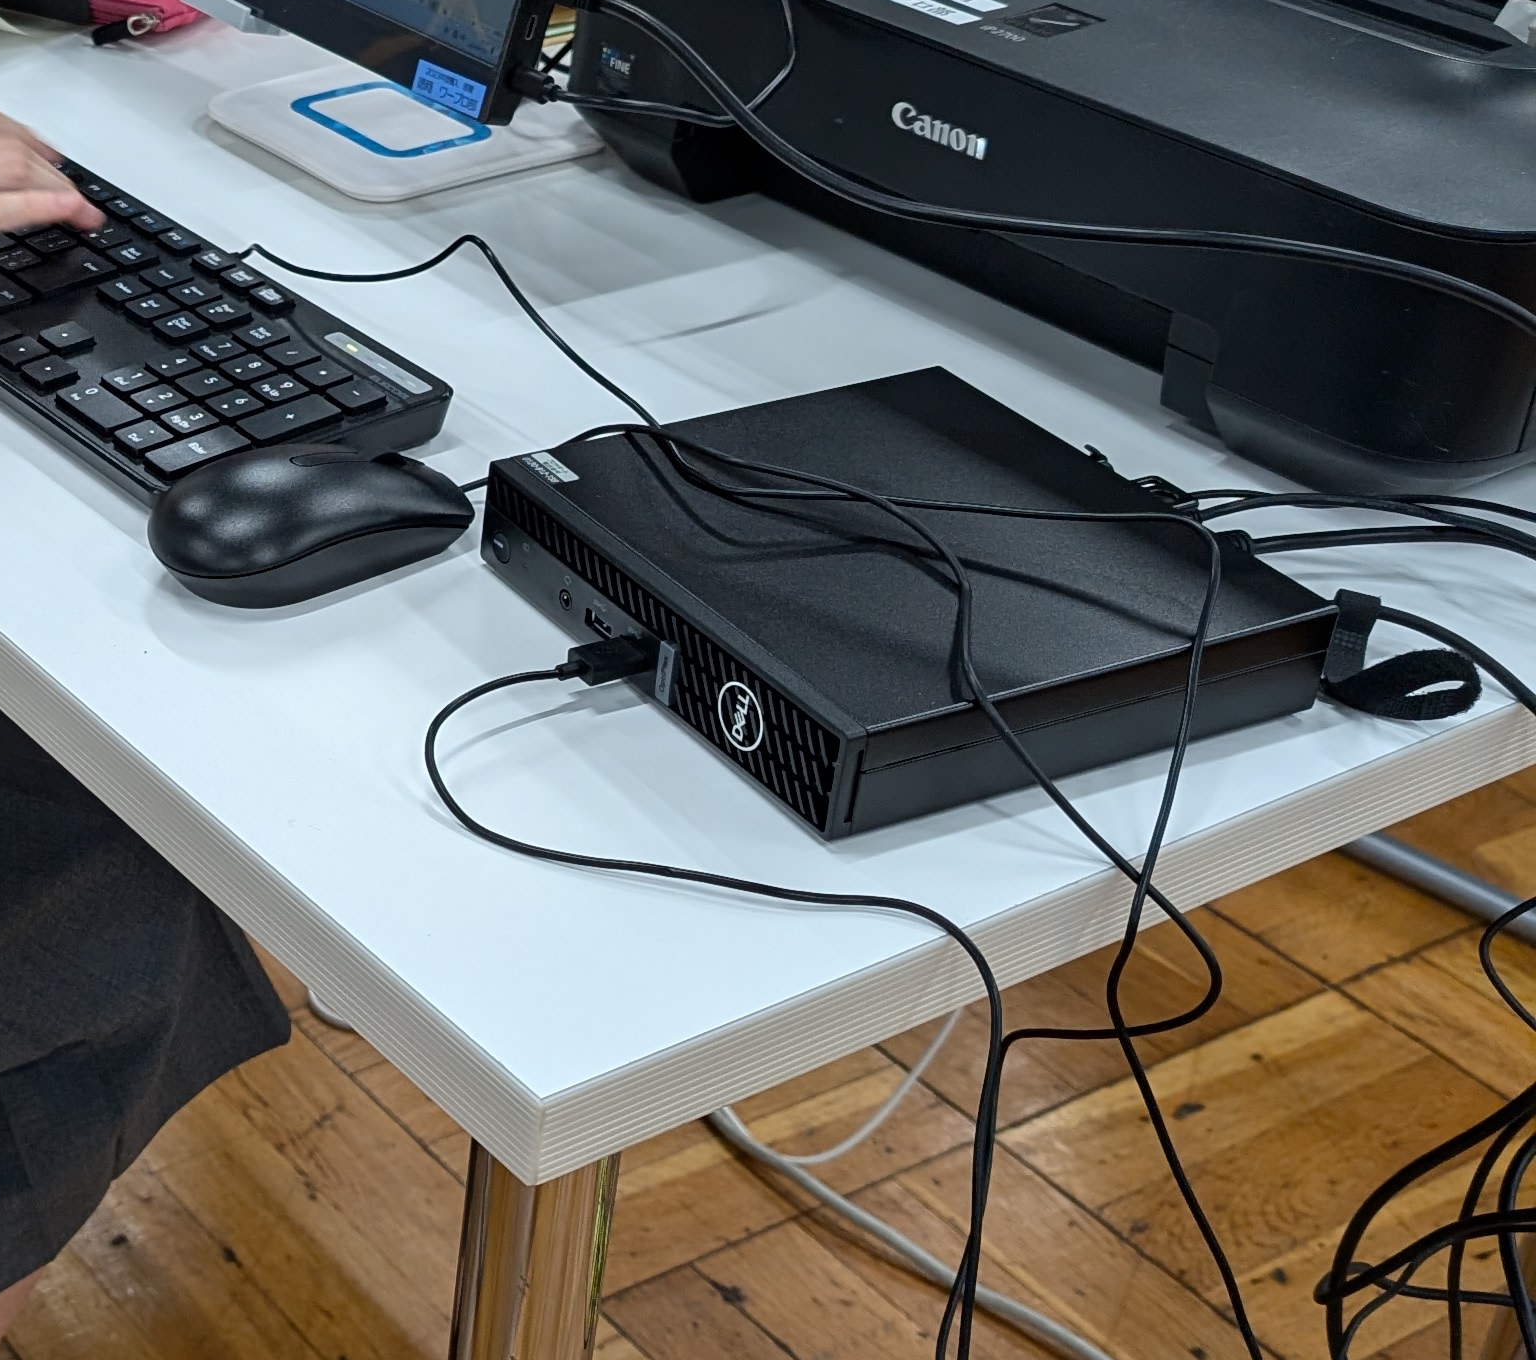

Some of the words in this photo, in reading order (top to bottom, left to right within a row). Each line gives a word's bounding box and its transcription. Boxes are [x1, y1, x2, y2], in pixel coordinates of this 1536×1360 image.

[980, 25, 1025, 41] iP2700
[610, 57, 630, 74] FINE
[891, 102, 988, 160] Canon
[732, 694, 750, 742] DELL
